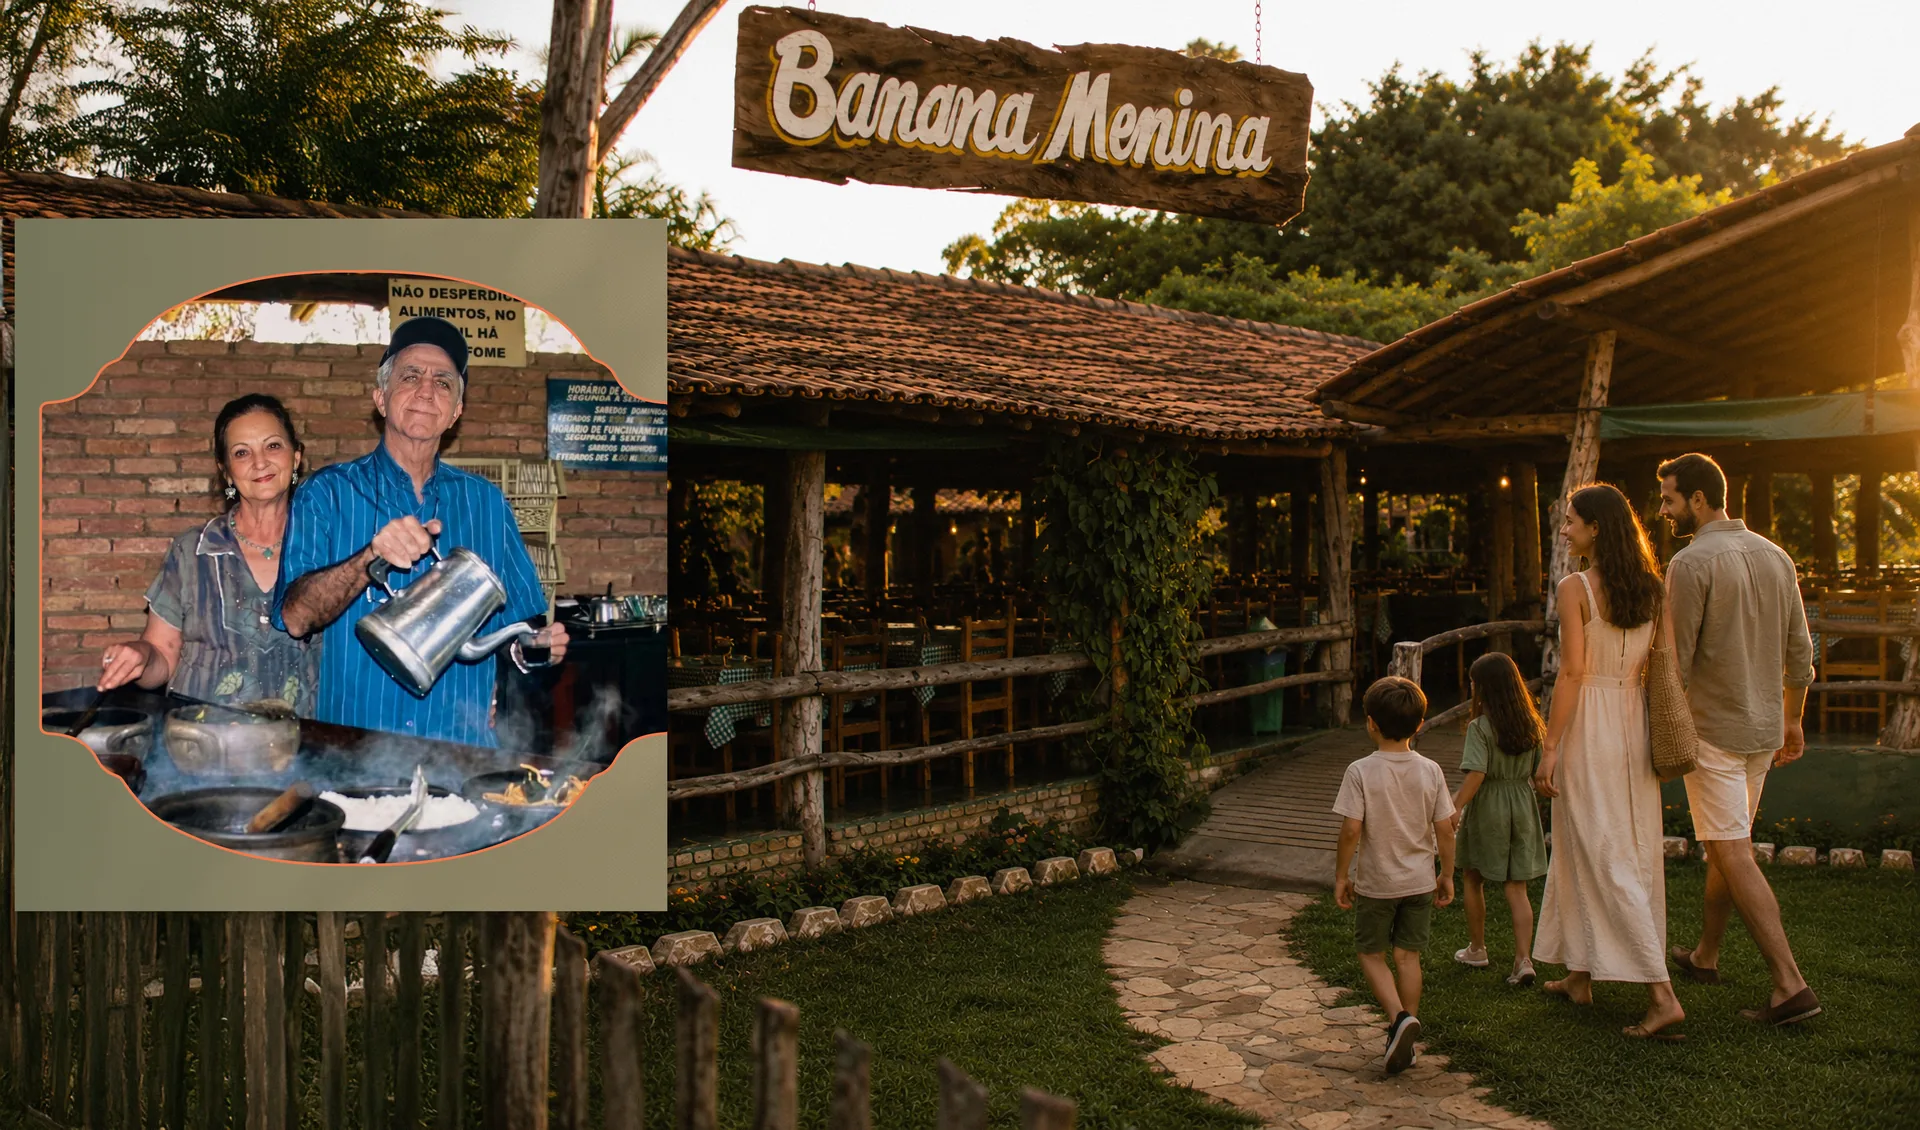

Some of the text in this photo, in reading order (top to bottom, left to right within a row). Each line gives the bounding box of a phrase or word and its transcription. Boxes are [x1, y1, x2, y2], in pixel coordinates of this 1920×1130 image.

[773, 29, 1273, 174] Banana Menina
[392, 284, 522, 303] NÃO DESPERDIC
[399, 306, 516, 322] ALIMENTOS, NO
[478, 326, 498, 339] HÁ
[568, 383, 607, 395] HORÁRIO
[610, 386, 619, 395] DE
[566, 394, 611, 402] SEGUNDA
[591, 425, 602, 434] DE
